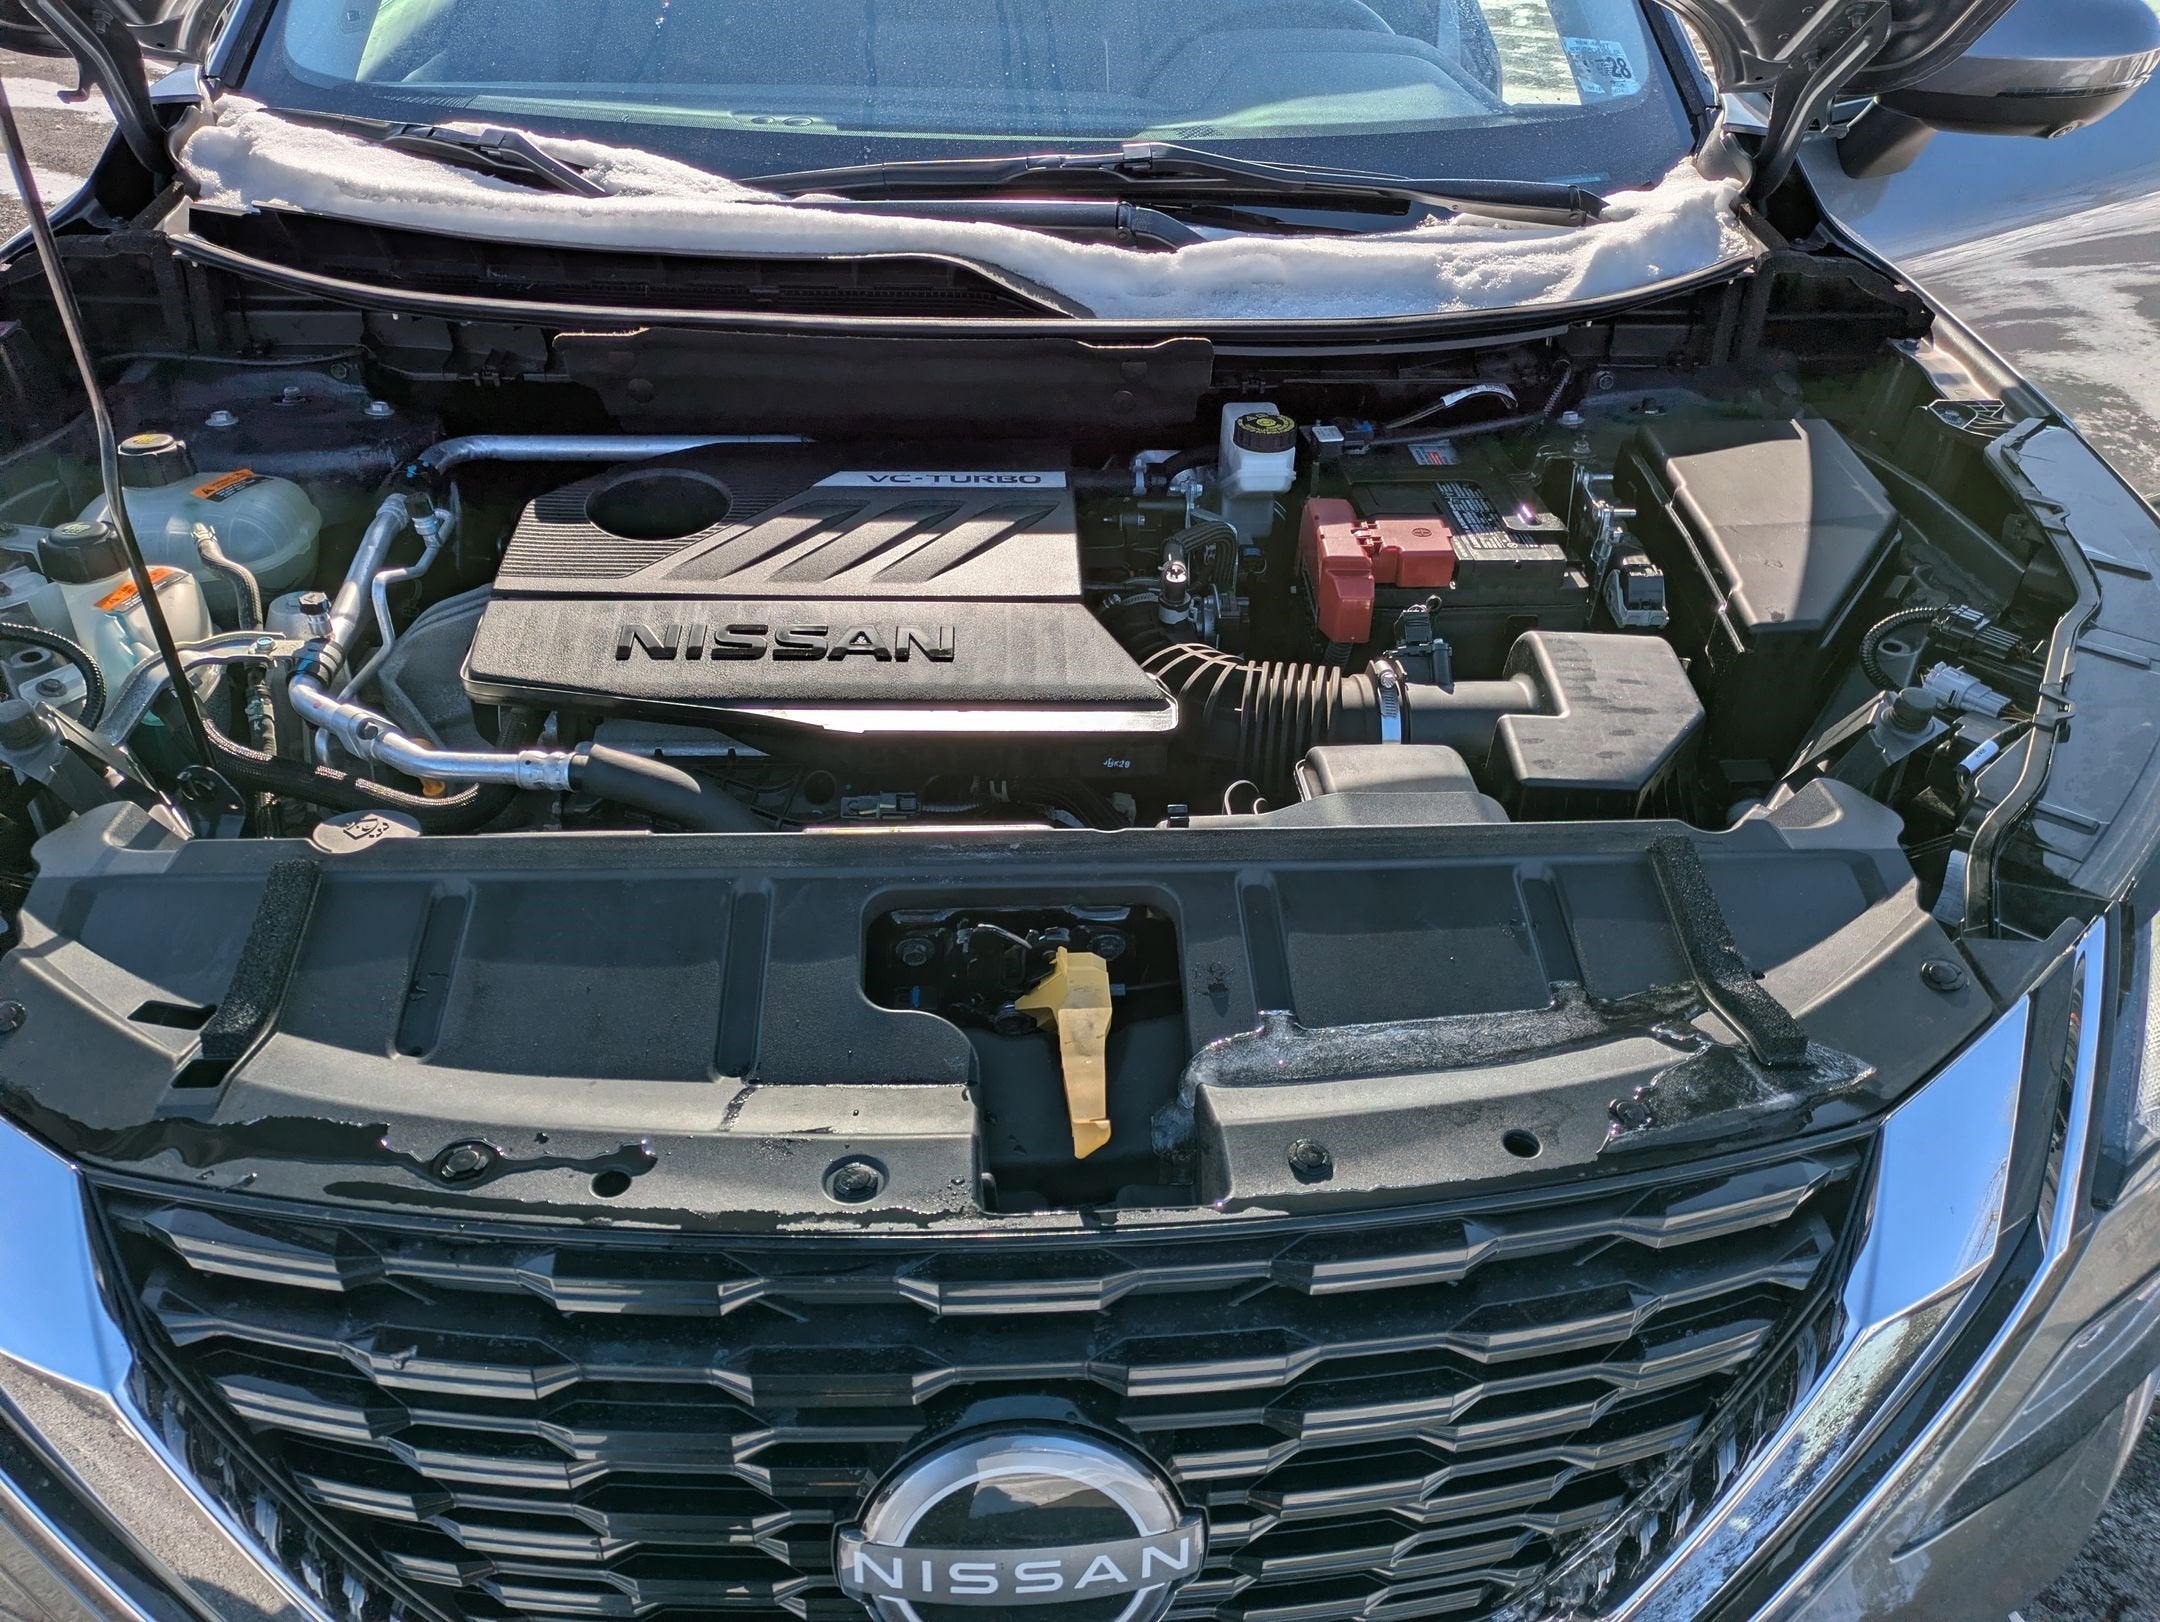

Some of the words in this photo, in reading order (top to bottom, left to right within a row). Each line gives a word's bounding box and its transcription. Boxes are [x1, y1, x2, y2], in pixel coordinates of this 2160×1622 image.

[1606, 56, 1632, 79] 28
[867, 474, 1042, 484] VC-TURBO
[615, 624, 955, 662] NISSAN
[854, 1538, 1189, 1595] NISSAN
